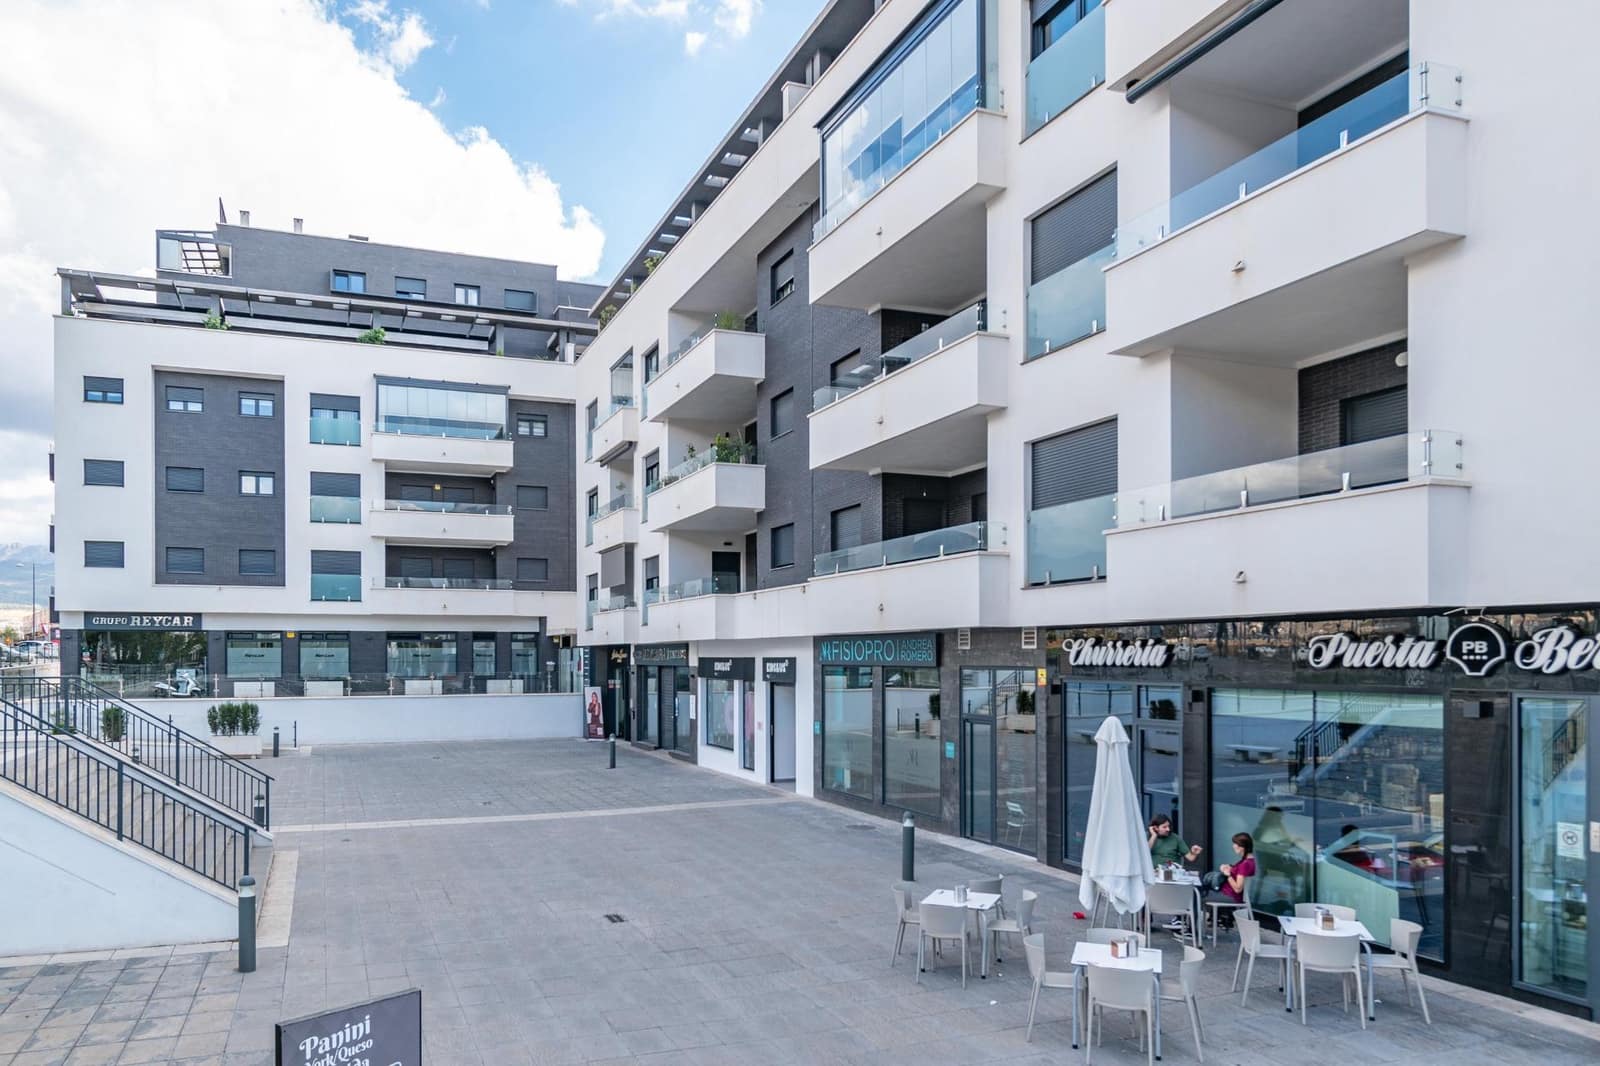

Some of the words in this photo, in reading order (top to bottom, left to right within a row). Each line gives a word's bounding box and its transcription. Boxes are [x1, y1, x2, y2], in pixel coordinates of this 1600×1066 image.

[92, 616, 128, 626] GRUPO
[129, 615, 194, 627] REYCAR
[902, 639, 933, 650] ANDREA
[1308, 632, 1438, 668] Puerta
[1462, 641, 1488, 654] PB
[901, 650, 933, 661] ROMERO
[299, 1014, 371, 1060] Panini
